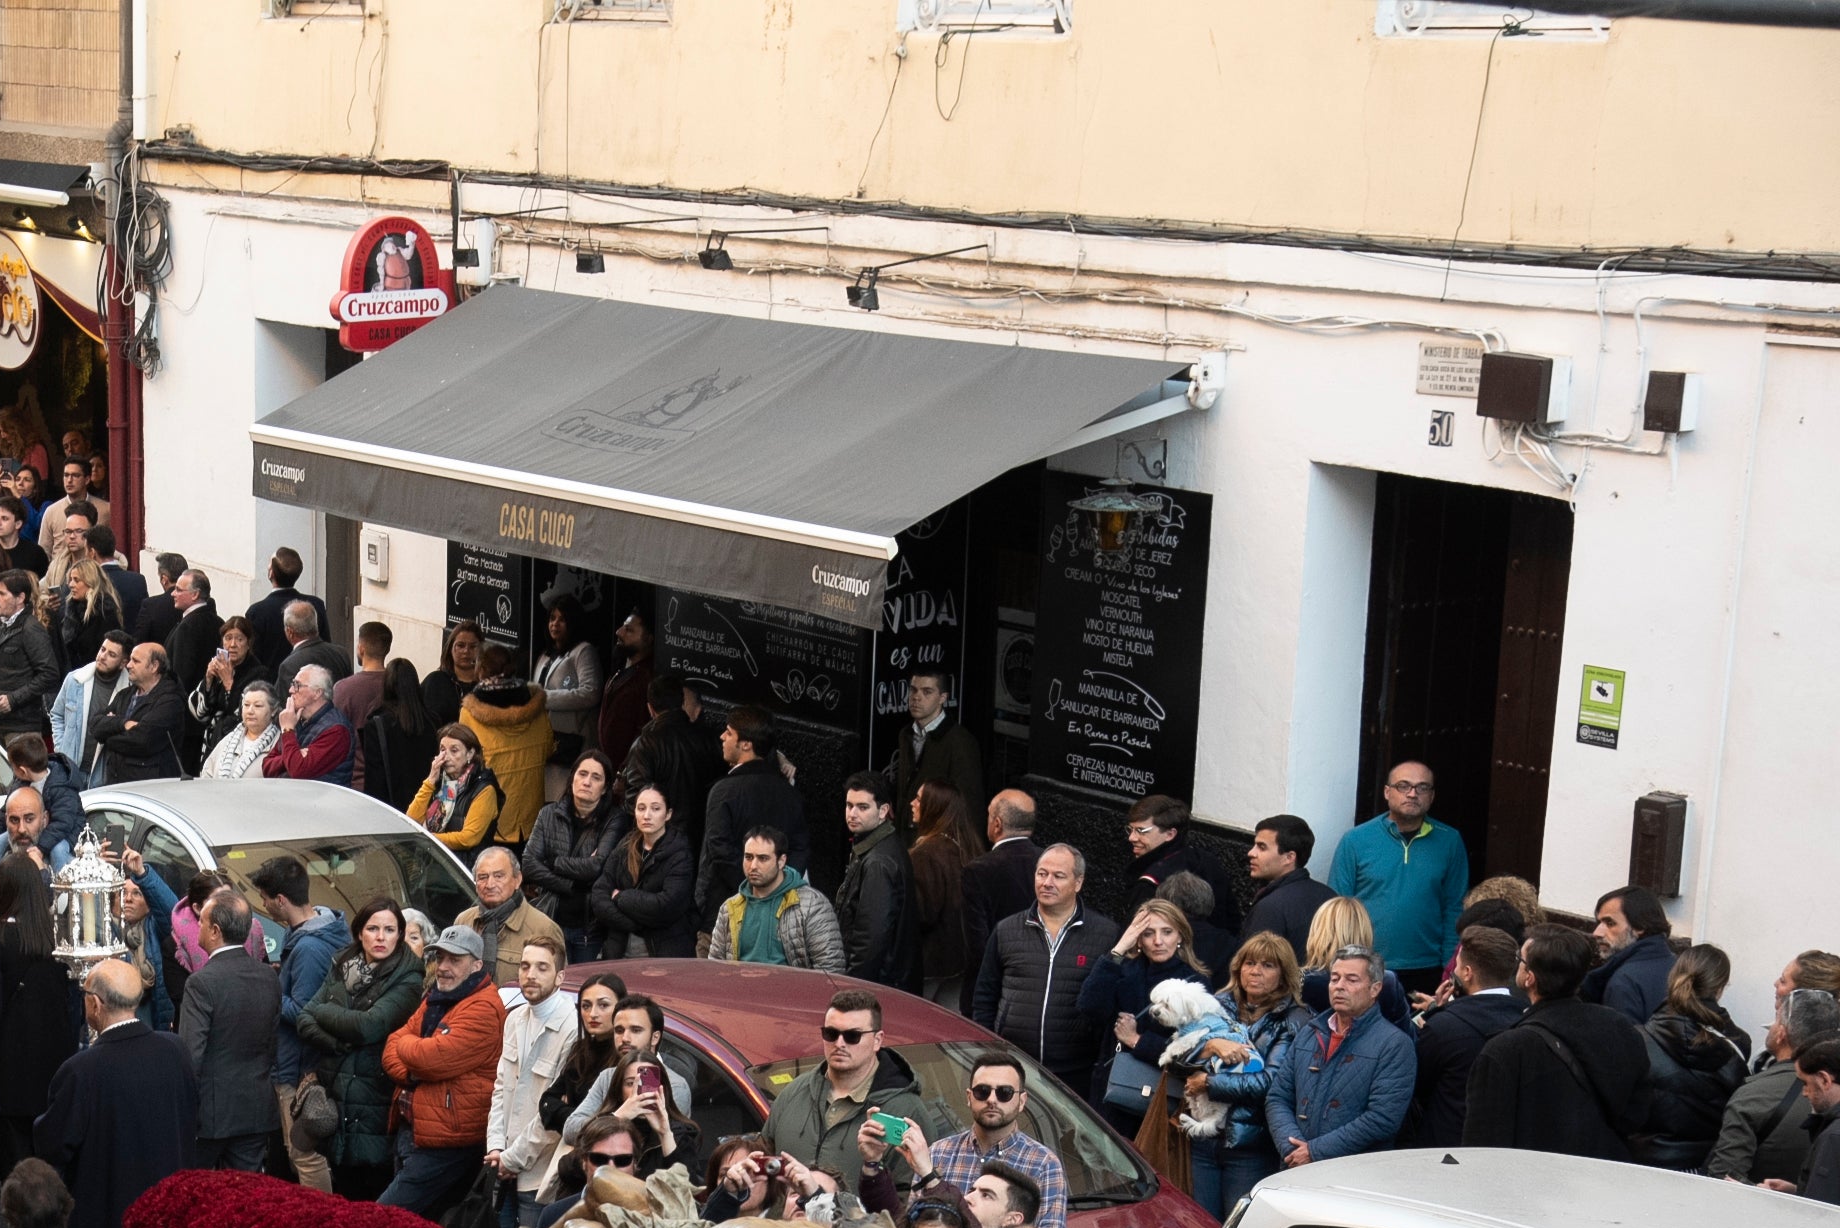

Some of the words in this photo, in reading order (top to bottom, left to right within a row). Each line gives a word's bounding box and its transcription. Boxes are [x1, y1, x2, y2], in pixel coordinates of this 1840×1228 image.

[348, 298, 440, 317] Cruzcampo
[369, 327, 391, 340] CASA
[1429, 411, 1454, 446] 50
[261, 458, 305, 483] Cruzcampo
[500, 503, 535, 541] CASA
[540, 510, 574, 548] CUCO
[1135, 548, 1147, 561] DE
[1149, 550, 1173, 566] JEREZ
[812, 565, 870, 597] Cruzcampo
[1065, 567, 1092, 583] CREAM
[1134, 563, 1156, 579] SECO
[822, 592, 857, 612] ESPECIAL
[1101, 590, 1141, 609] MOSCATEL
[882, 589, 957, 634] VIDA
[1100, 605, 1142, 624] VERMOUTH
[1085, 618, 1104, 632] VINO
[1106, 621, 1117, 634] DE
[1119, 624, 1154, 641] NARANJA
[766, 643, 806, 662] BUTIFARRA
[1083, 633, 1110, 648] MOSTO
[1112, 637, 1123, 651] DE
[1125, 640, 1154, 656] HUELVA
[891, 645, 911, 670] es
[918, 643, 944, 663] un
[1103, 651, 1133, 668] MISTELA
[1078, 682, 1125, 702] MANZANILLA
[1127, 693, 1138, 706] DE
[1101, 708, 1112, 721] DE
[1113, 710, 1160, 732] BARRAMEDA
[1121, 731, 1152, 749] Pasada
[1066, 753, 1106, 772] CERVEZAS
[1107, 762, 1155, 785] NACIONALES
[1073, 768, 1078, 779] E
[1080, 769, 1146, 795] INTERNACIONALES
